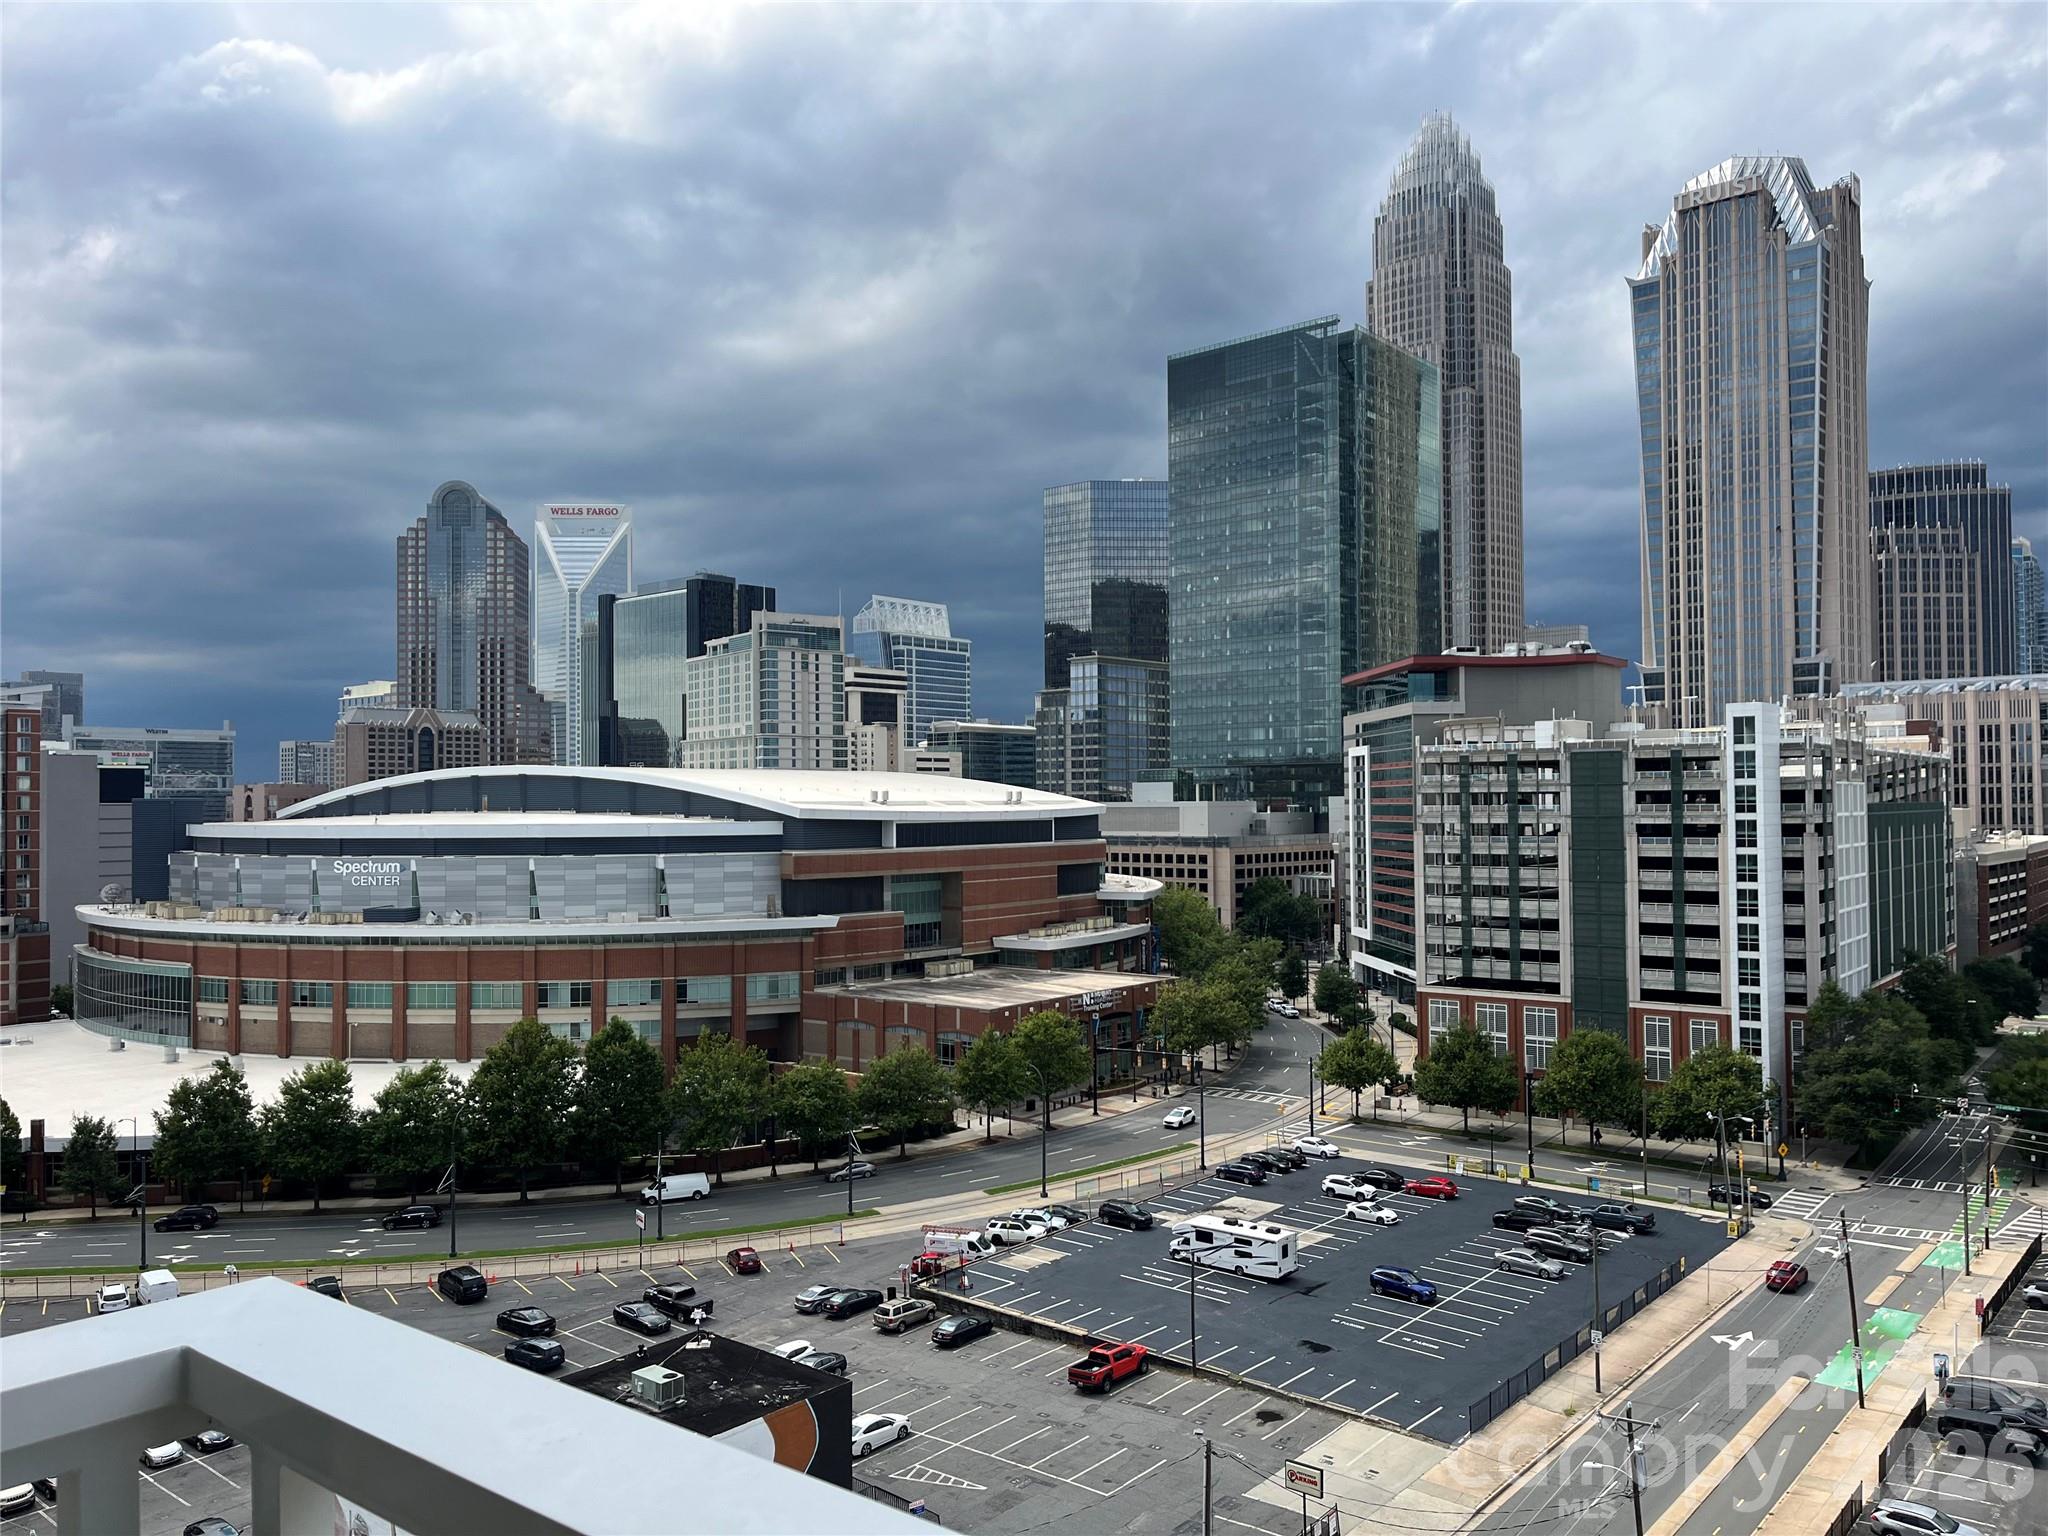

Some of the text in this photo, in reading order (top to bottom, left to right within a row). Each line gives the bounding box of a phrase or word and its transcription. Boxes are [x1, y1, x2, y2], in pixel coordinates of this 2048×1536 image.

[550, 507, 619, 516] WELLS FARGO
[333, 860, 401, 876] Spectrum
[351, 875, 401, 887] CENTER
